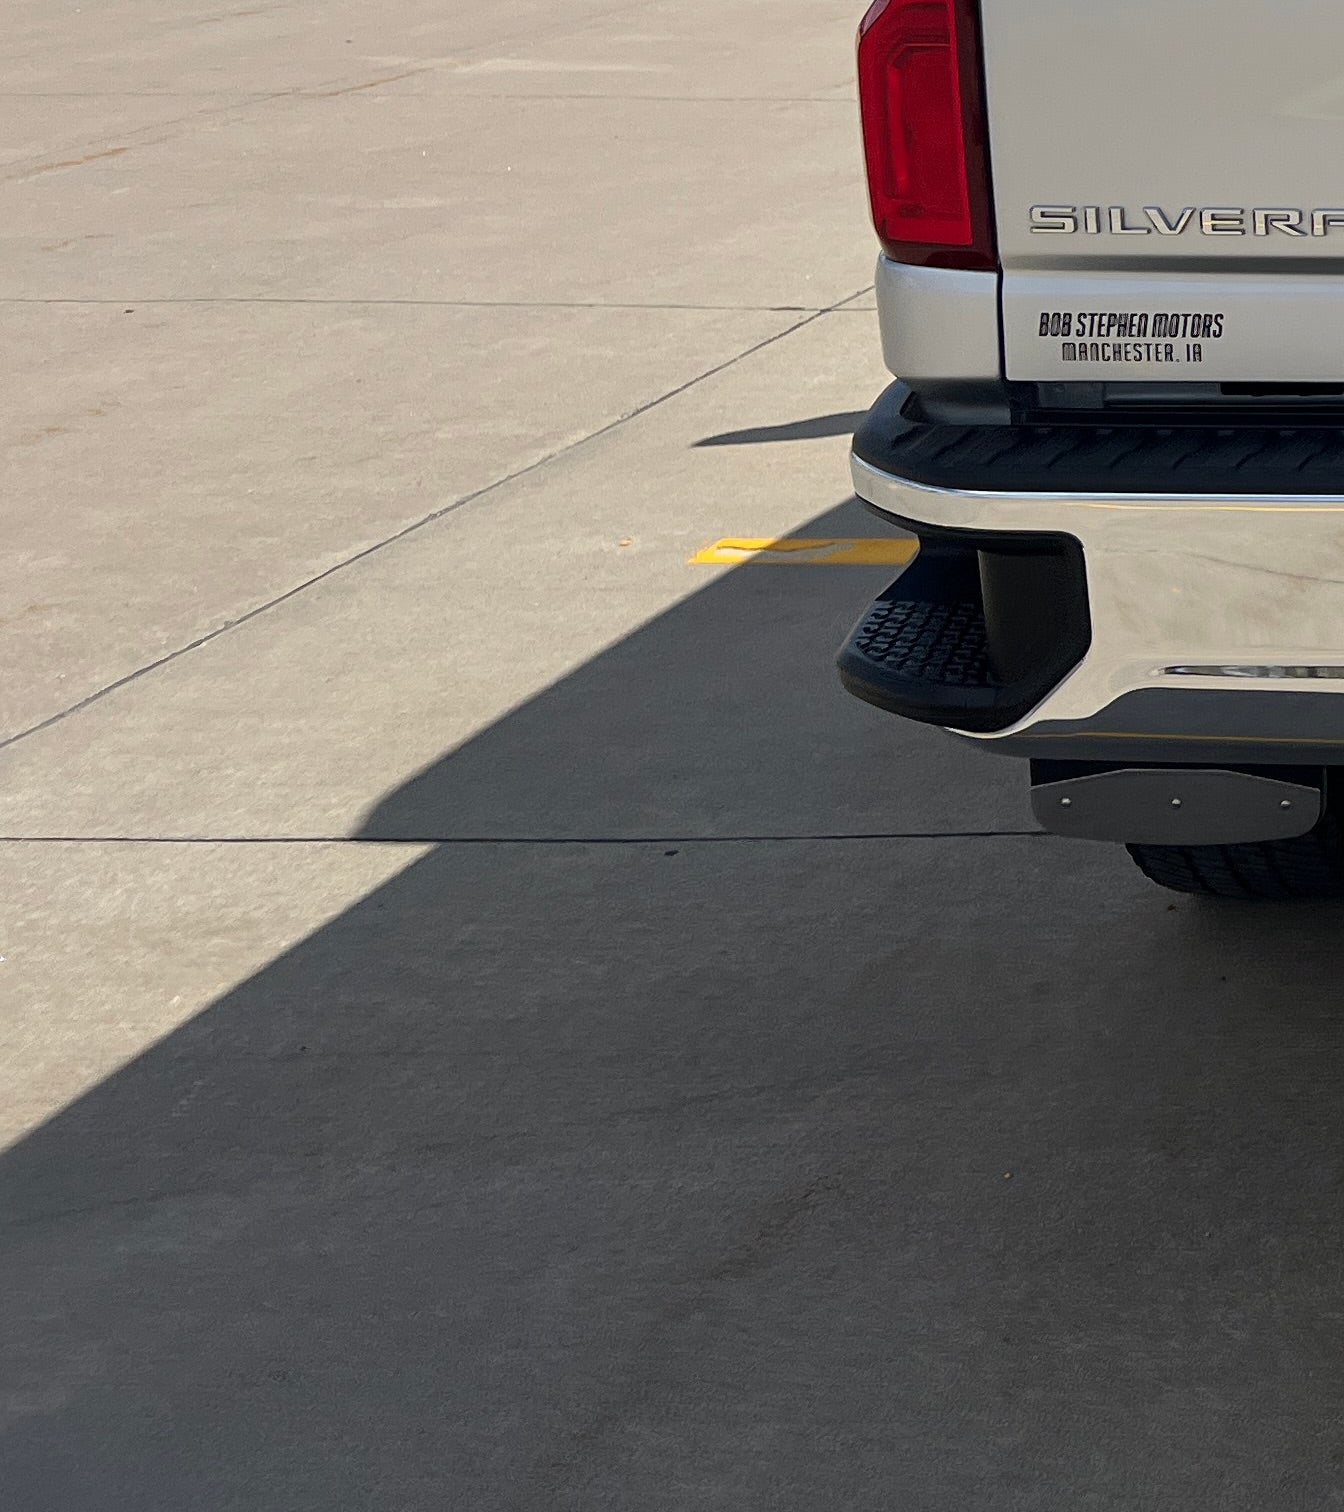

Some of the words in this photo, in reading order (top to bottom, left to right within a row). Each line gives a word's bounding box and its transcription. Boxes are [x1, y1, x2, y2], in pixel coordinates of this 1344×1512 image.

[1039, 312, 1072, 337] BOB
[1075, 312, 1149, 338] STEPHEN
[1152, 313, 1224, 339] MOTORS
[1186, 343, 1203, 363] IA
